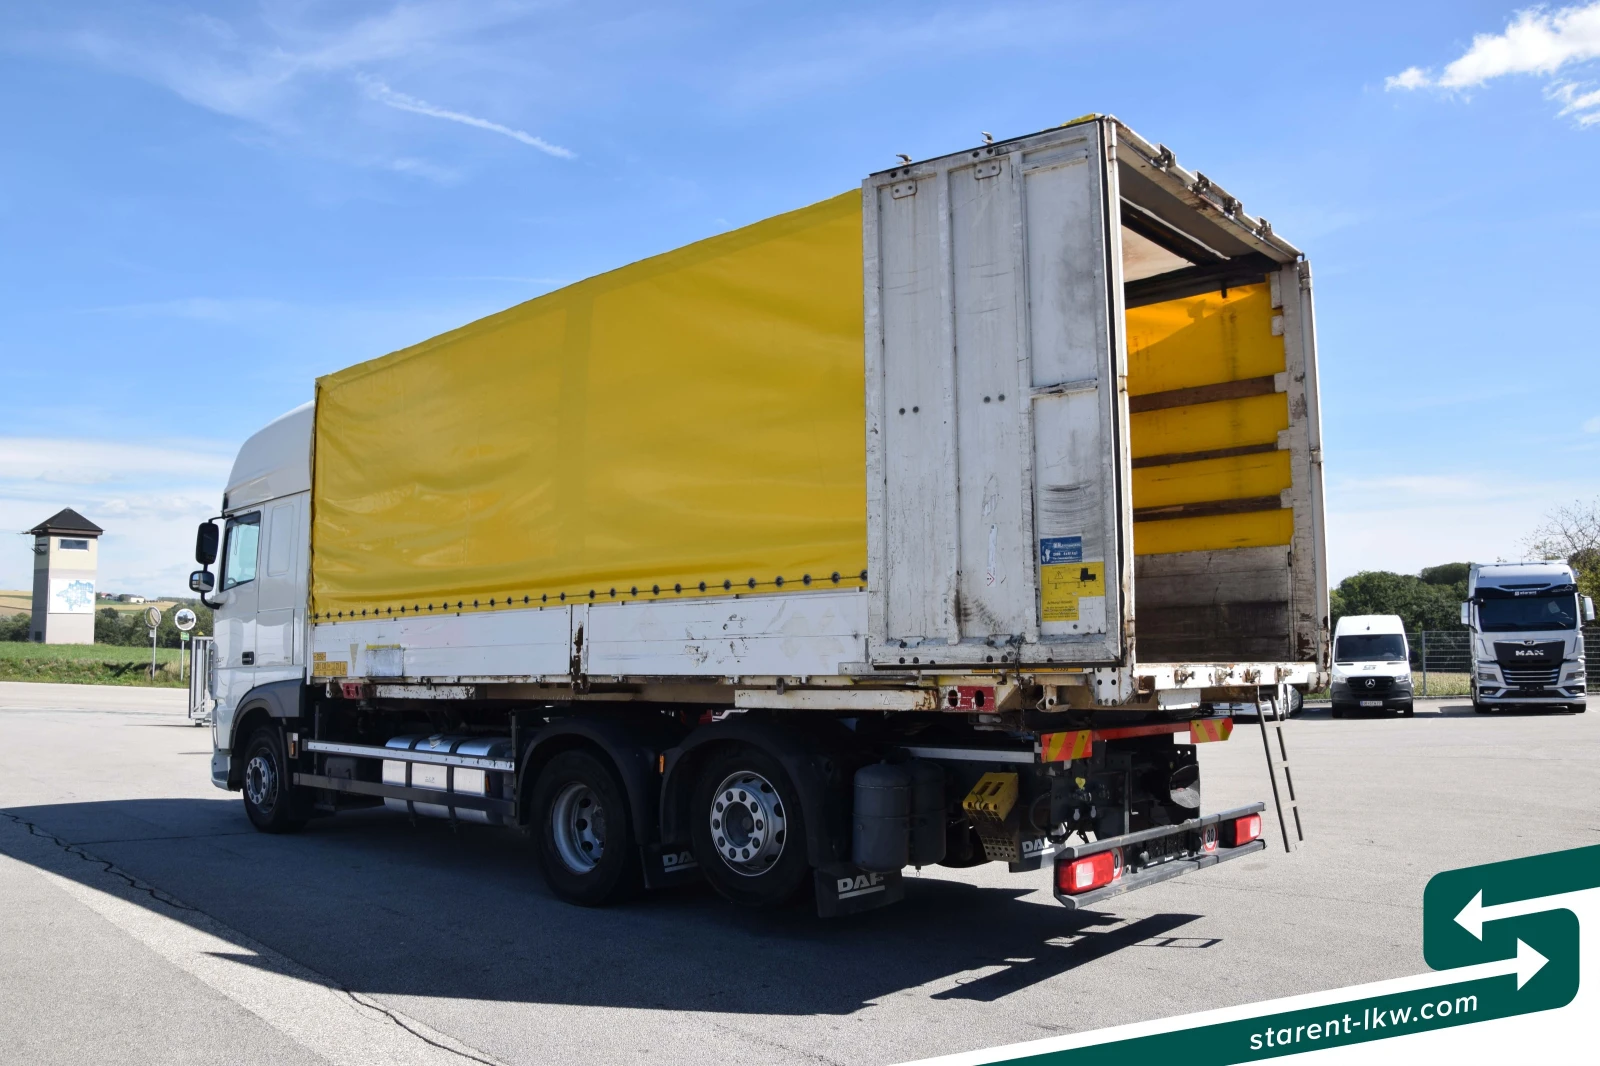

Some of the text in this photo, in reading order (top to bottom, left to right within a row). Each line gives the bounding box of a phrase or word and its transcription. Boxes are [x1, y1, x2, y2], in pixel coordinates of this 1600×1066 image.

[1206, 828, 1215, 843] 80
[662, 850, 694, 867] DA
[837, 872, 884, 892] DAF
